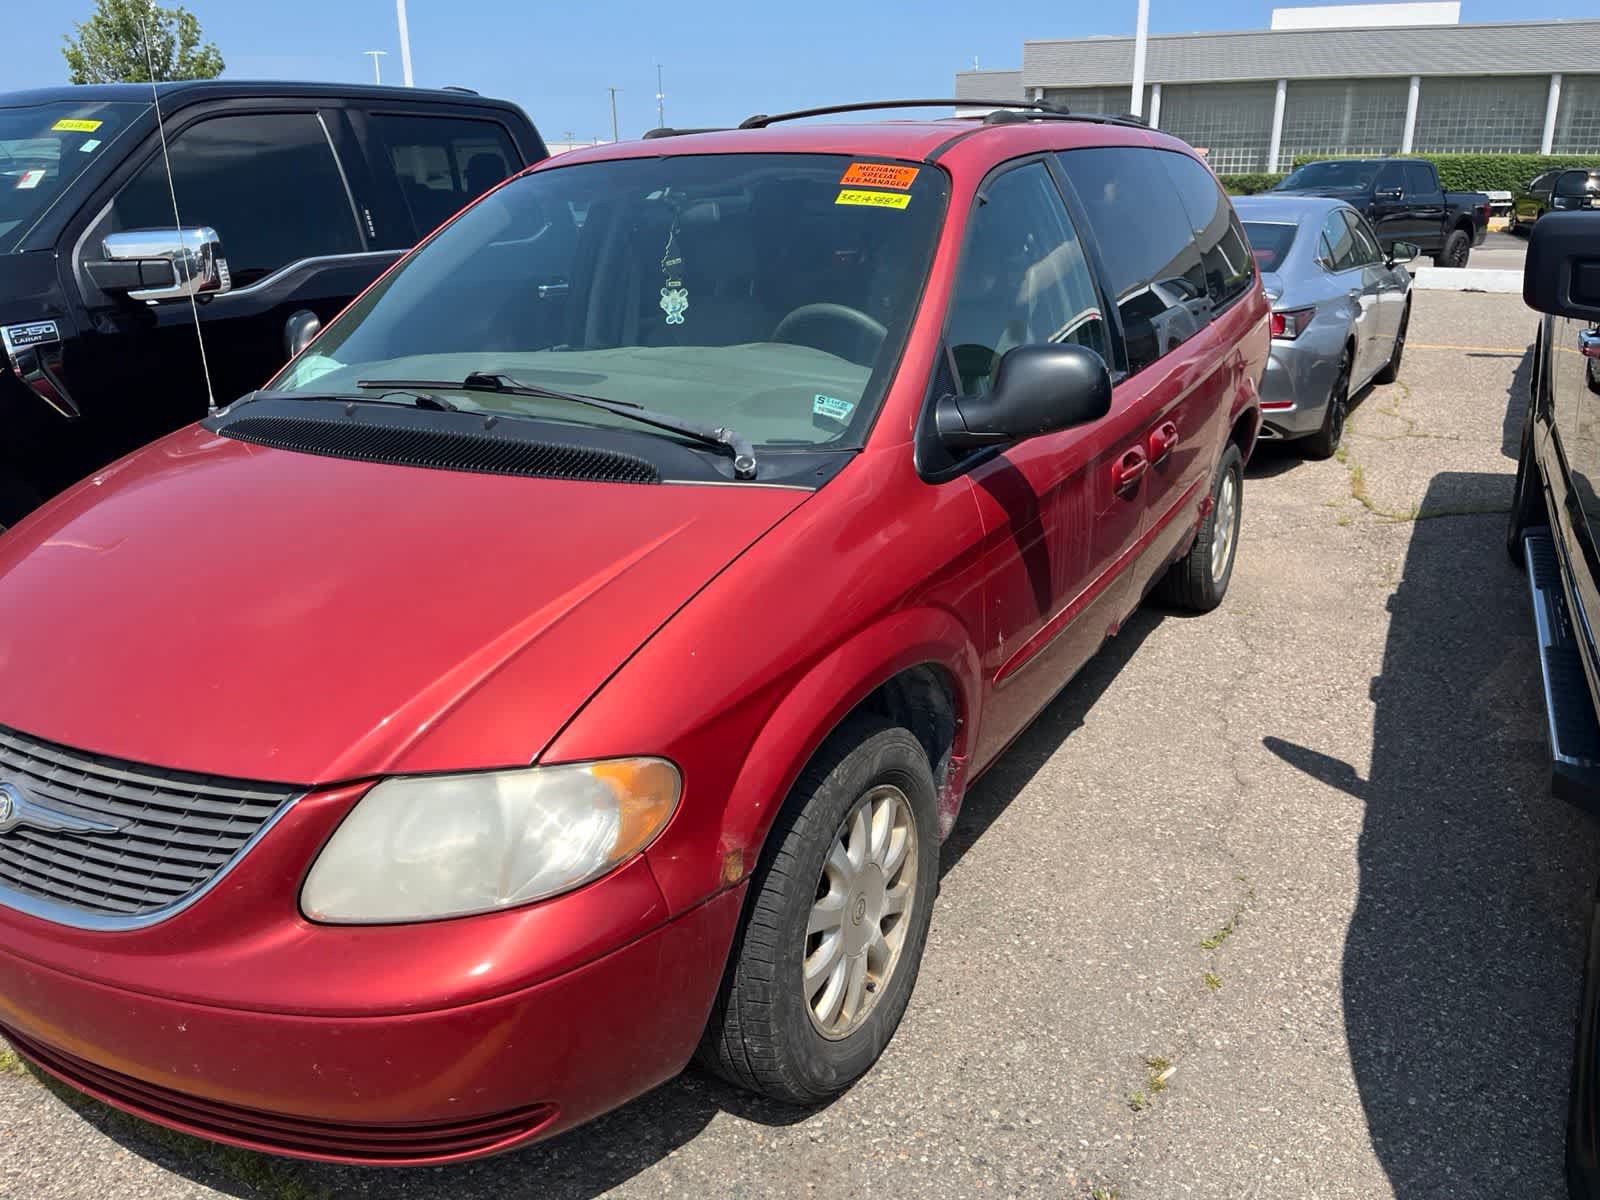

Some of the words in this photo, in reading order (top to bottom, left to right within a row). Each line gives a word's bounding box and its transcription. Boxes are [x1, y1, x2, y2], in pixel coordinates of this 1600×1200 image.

[858, 166, 909, 174] MECHANICS
[863, 178, 908, 187] MANAGER
[10, 325, 55, 338] F-150
